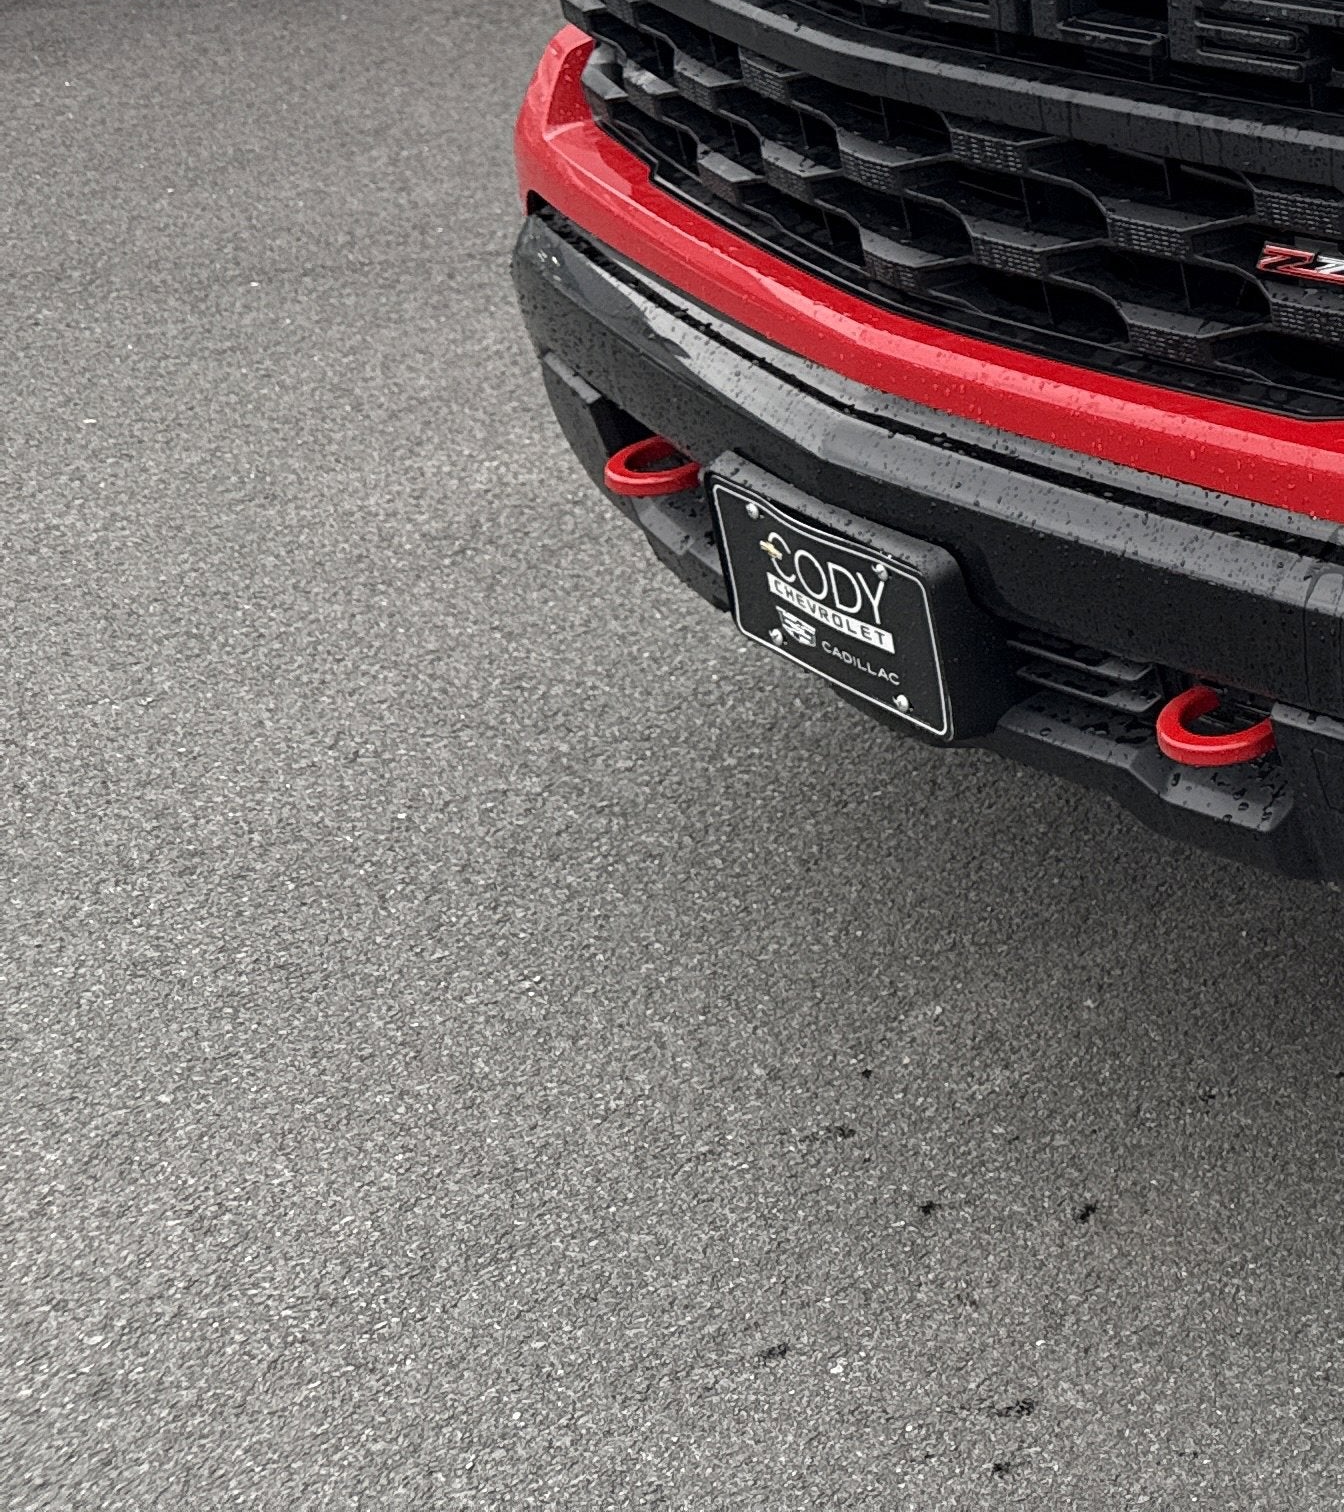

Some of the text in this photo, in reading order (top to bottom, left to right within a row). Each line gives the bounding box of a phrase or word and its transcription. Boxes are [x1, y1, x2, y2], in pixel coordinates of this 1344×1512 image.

[764, 531, 885, 625] CODY
[774, 579, 886, 646] CHEVROLET
[822, 640, 901, 686] CADILLAC
